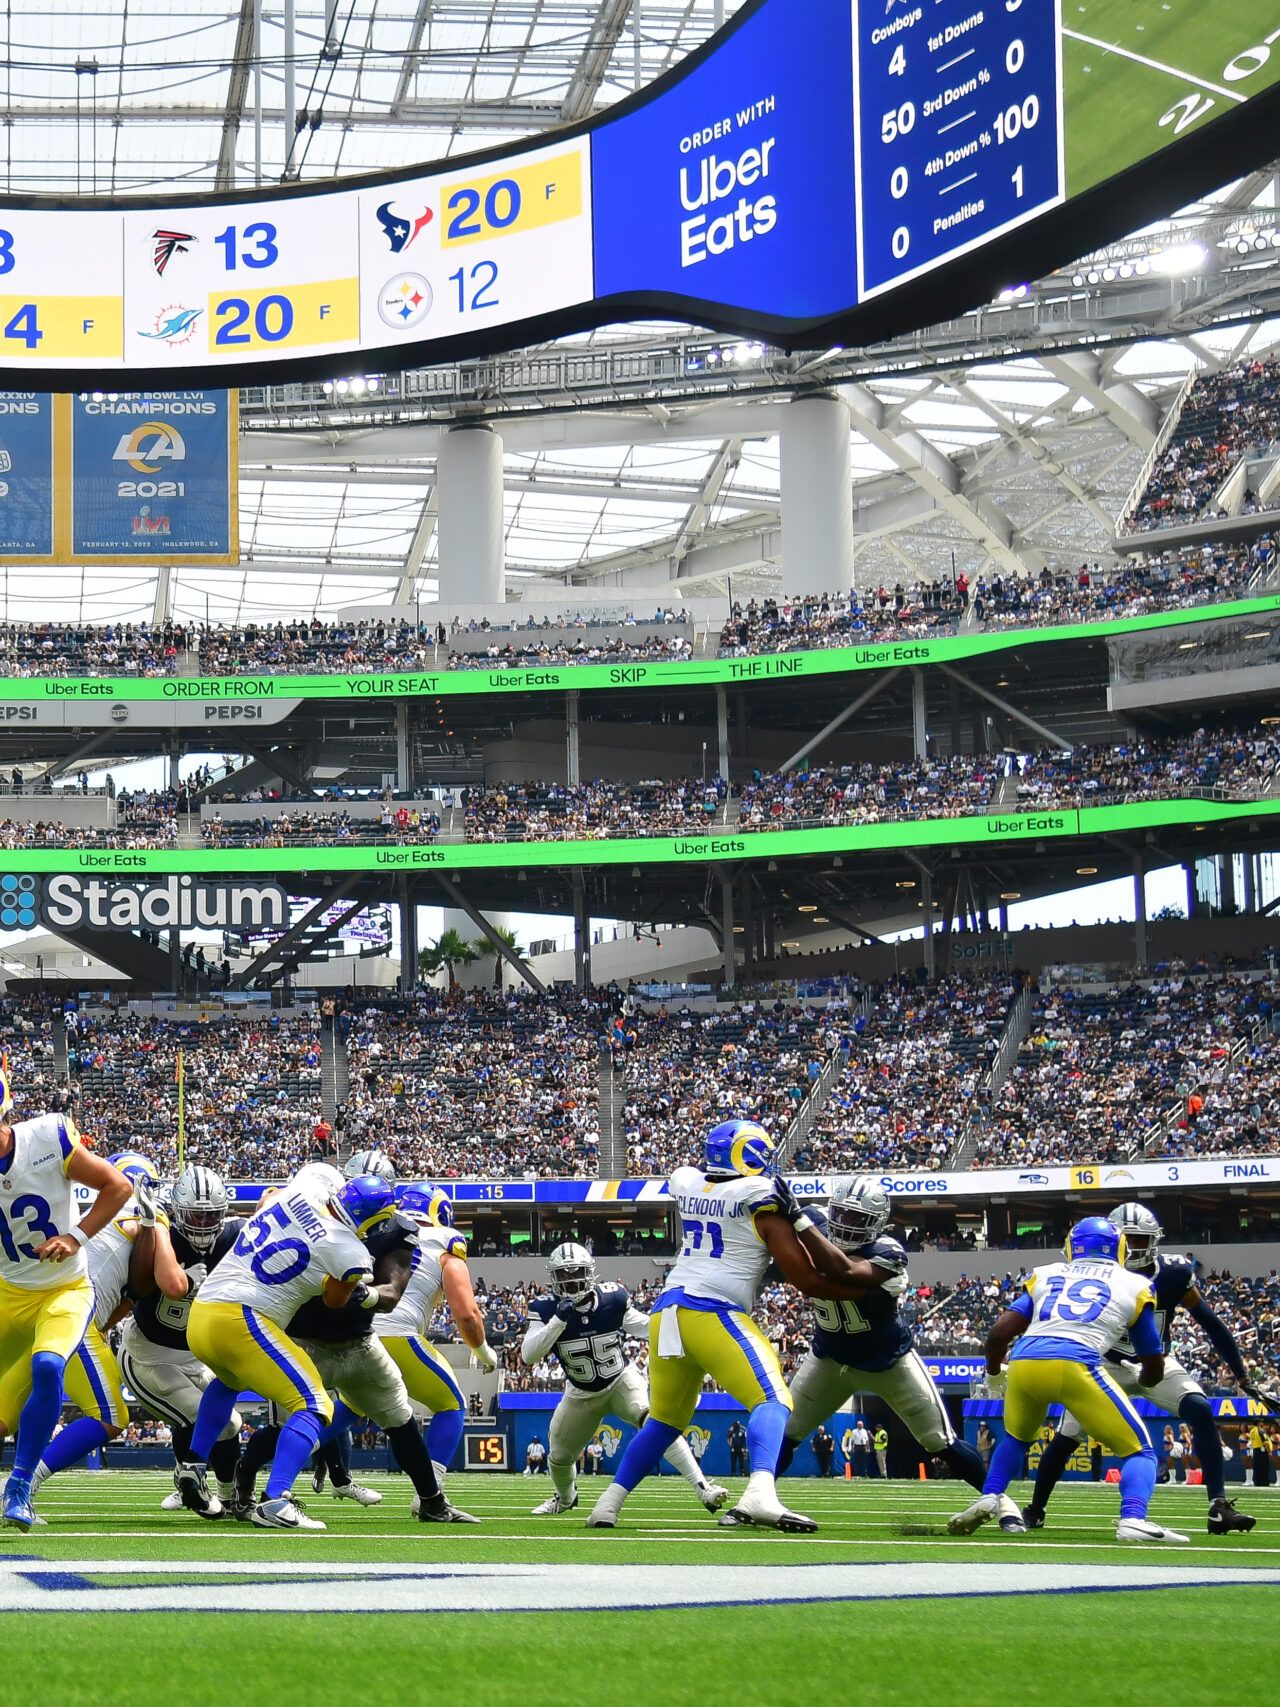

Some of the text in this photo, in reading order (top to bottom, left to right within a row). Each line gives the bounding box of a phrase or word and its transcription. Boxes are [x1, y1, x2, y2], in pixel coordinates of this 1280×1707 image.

[872, 8, 922, 45] Cowboys
[927, 11, 984, 52] 1st Downs
[888, 44, 907, 76] 4
[1005, 39, 1024, 74] 0
[923, 68, 990, 117] 3rd Down %
[679, 95, 776, 153] ORDER WITH
[881, 101, 916, 144] 50
[993, 94, 1039, 145] 100
[925, 131, 991, 177] 4th Down %
[679, 137, 775, 211] Uber
[890, 166, 909, 199] 0
[1011, 164, 1023, 199] 1
[447, 179, 557, 239] 20 F
[933, 199, 985, 235] Penalties
[681, 195, 777, 268] Eats
[892, 226, 910, 259] 0
[215, 222, 279, 270] 13
[449, 261, 499, 313] 12
[82, 319, 94, 334] F
[215, 295, 331, 346] 20 F
[85, 402, 217, 415] CHAMPIONS
[143, 392, 204, 400] BOWL LVI
[117, 481, 185, 497] 2021
[162, 541, 207, 549] INGLEWOOD,
[855, 645, 930, 664] Uber Eats
[488, 673, 560, 687] Uber Eats
[609, 658, 803, 685] SKIP THE LINE
[45, 682, 114, 695] Uber Eats
[163, 678, 439, 696] ORDER FROM YOUR SEAT
[204, 705, 262, 719] PEPSI
[987, 817, 1064, 833] Uber Eats
[79, 854, 147, 866] Uber Eats
[376, 850, 446, 863] Uber Eats
[674, 840, 745, 855] Uber Eats
[47, 875, 283, 926] Stadium
[952, 941, 993, 960] SoFi
[32, 1152, 56, 1167] RAMS
[1223, 1164, 1269, 1178] FINAL
[880, 1177, 948, 1193] Scores
[1075, 1171, 1094, 1184] 16
[1168, 1167, 1179, 1181] 3
[75, 1187, 89, 1198] 10
[479, 1186, 504, 1199] :15
[287, 1192, 327, 1243] LIMMER
[729, 1201, 746, 1218] JR
[233, 1201, 310, 1286] 50
[1061, 1264, 1113, 1279] SMITH
[1039, 1276, 1112, 1323] 19
[557, 1330, 625, 1383] 55
[479, 1437, 502, 1463] 15
[1028, 1457, 1092, 1472] RMS
